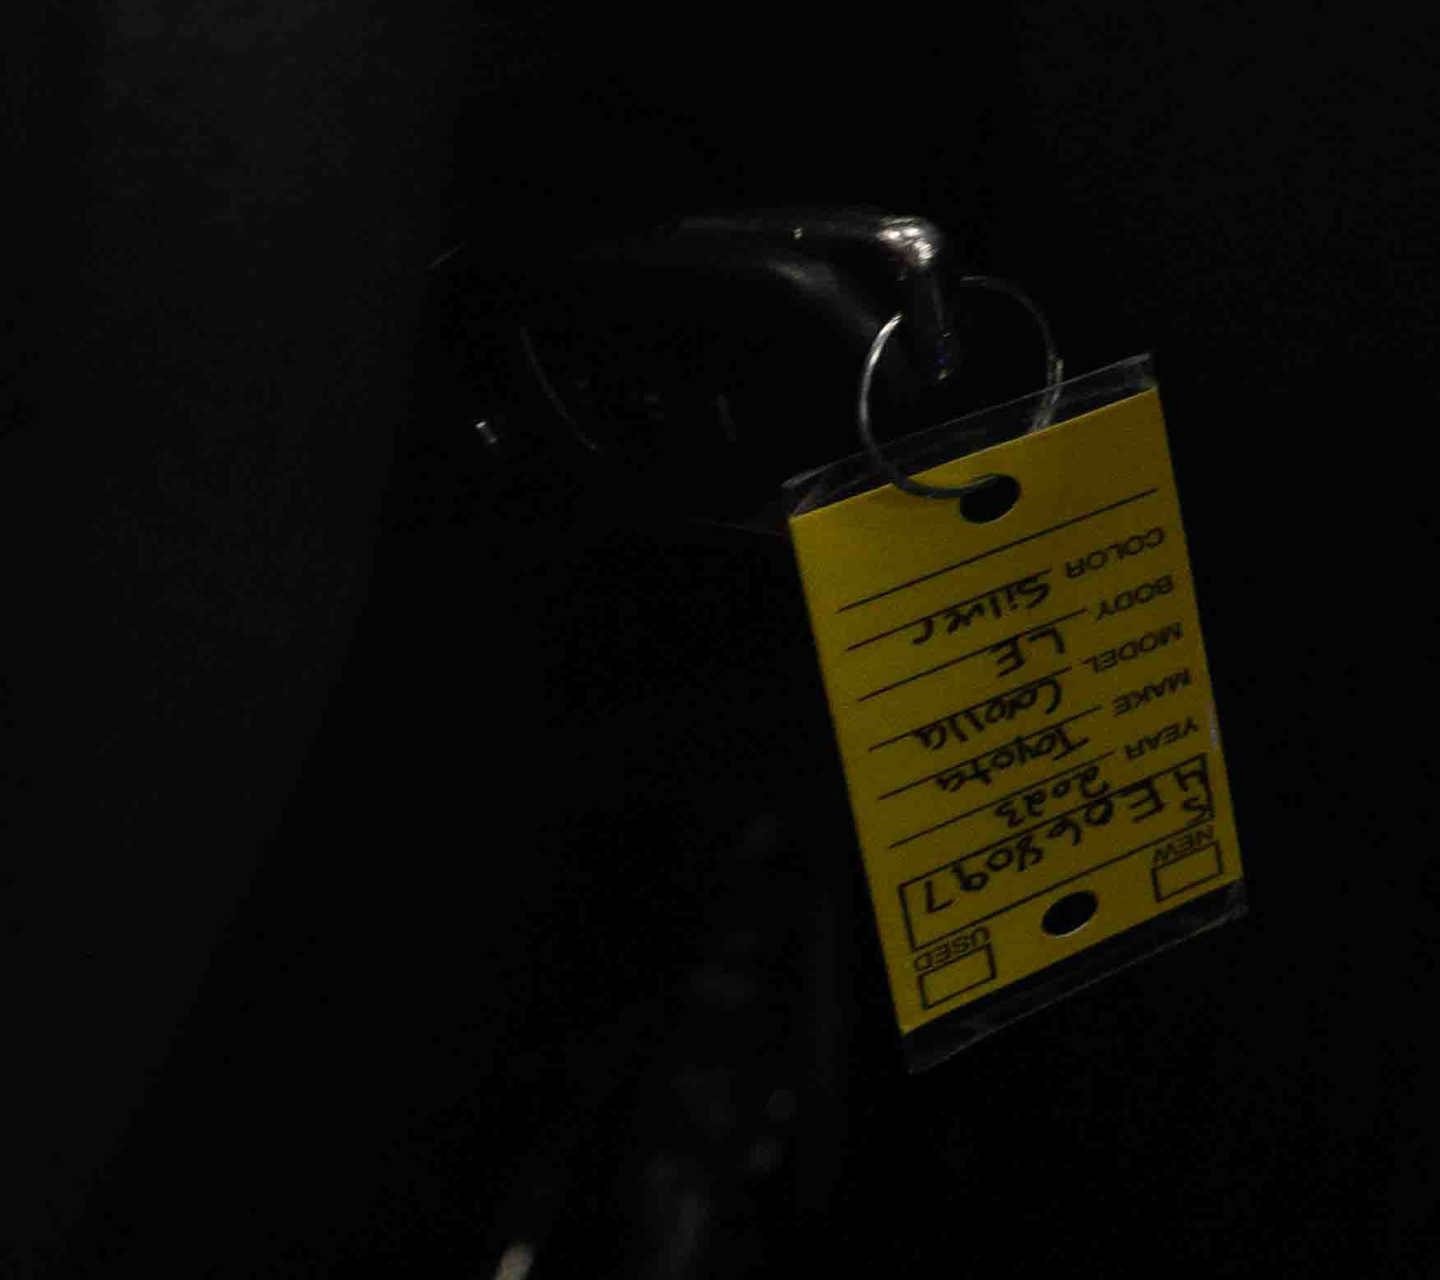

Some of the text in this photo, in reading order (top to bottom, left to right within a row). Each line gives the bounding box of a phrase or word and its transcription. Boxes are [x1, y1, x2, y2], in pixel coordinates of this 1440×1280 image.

[1064, 526, 1167, 580] COLOR
[911, 576, 1052, 646] Silver
[1095, 574, 1176, 622] BODY
[989, 625, 1067, 679] LE
[1079, 621, 1184, 675] MODEL
[1110, 667, 1193, 718] MAKE
[934, 727, 1090, 793] Toyota
[1123, 717, 1199, 762] YEAR
[1151, 823, 1217, 869] NEW
[912, 926, 992, 973] USED
